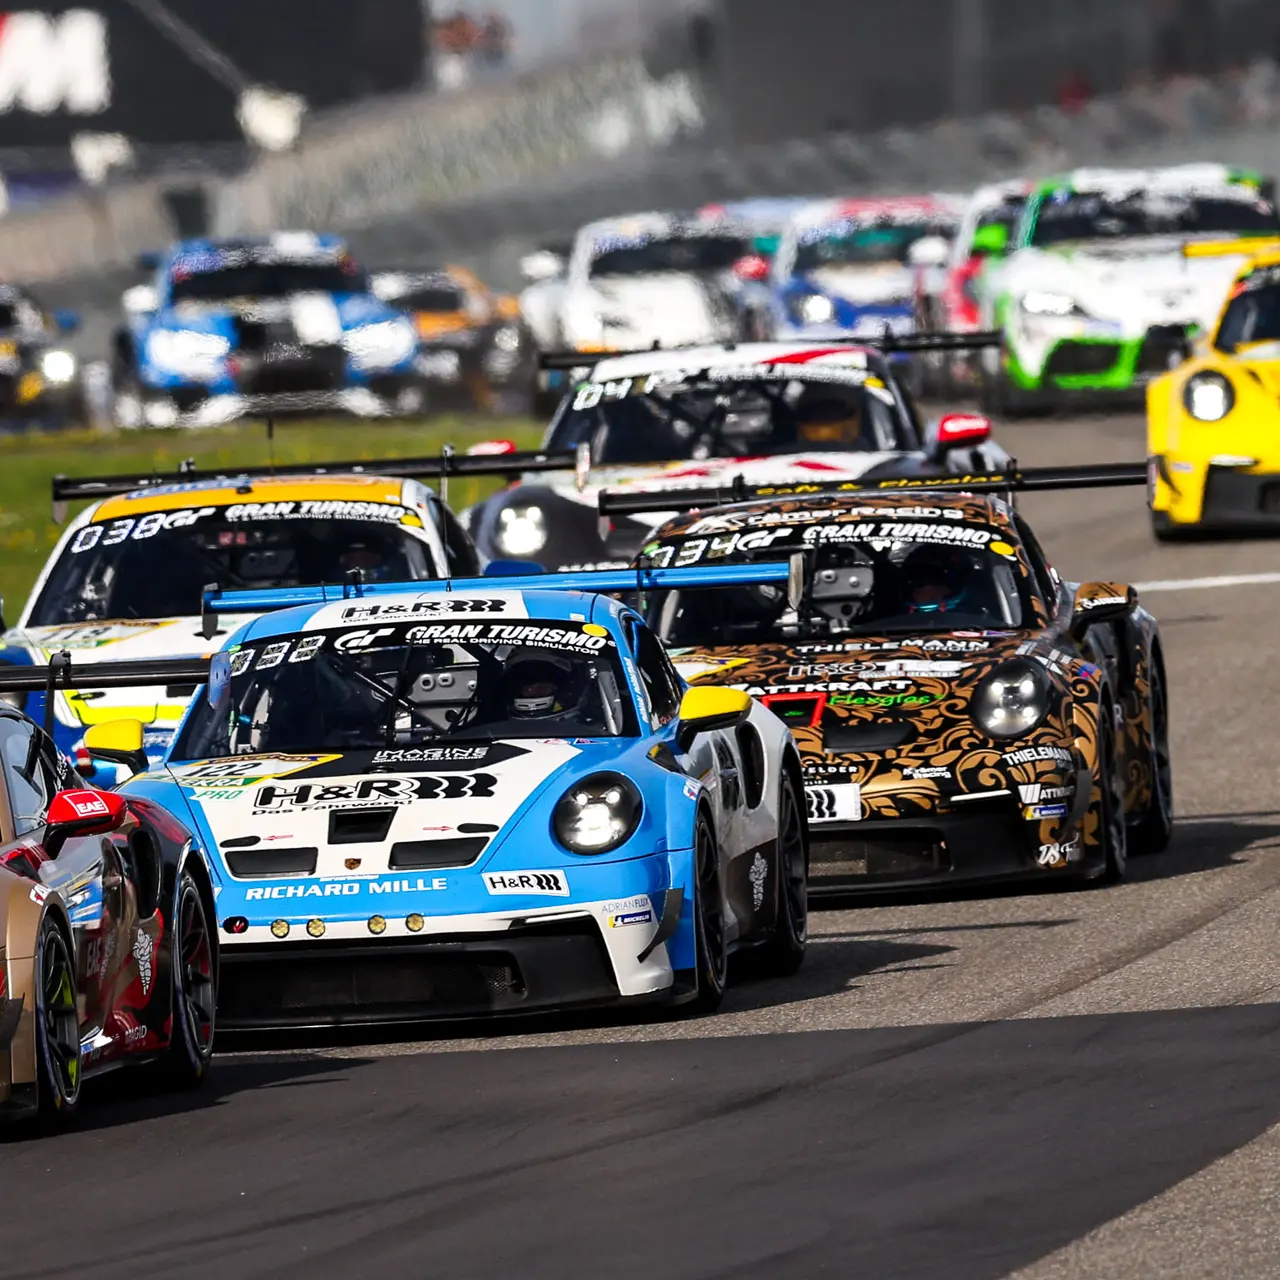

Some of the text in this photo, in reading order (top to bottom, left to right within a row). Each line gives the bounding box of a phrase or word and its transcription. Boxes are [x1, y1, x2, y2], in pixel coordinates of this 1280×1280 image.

[225, 502, 295, 518] GRAN
[300, 501, 404, 519] TURISMO
[851, 507, 963, 519] Racing
[72, 512, 167, 554] 038
[803, 525, 873, 540] GRAN
[879, 523, 992, 545] TURISMO
[916, 538, 984, 549] SIMULATOR
[405, 625, 484, 639] GRAN
[489, 625, 606, 648] TURISMO
[470, 638, 522, 647] DRIVING
[526, 641, 599, 656] SIMULATOR
[796, 639, 989, 653] THIELEMANN
[829, 694, 929, 707] Flexglas
[190, 762, 258, 777] 122
[200, 789, 243, 801] PRO
[76, 801, 104, 813] EAE
[252, 799, 412, 816] Das Fahrwerk!
[246, 881, 360, 900] RICHARD
[369, 877, 447, 895] MILLE
